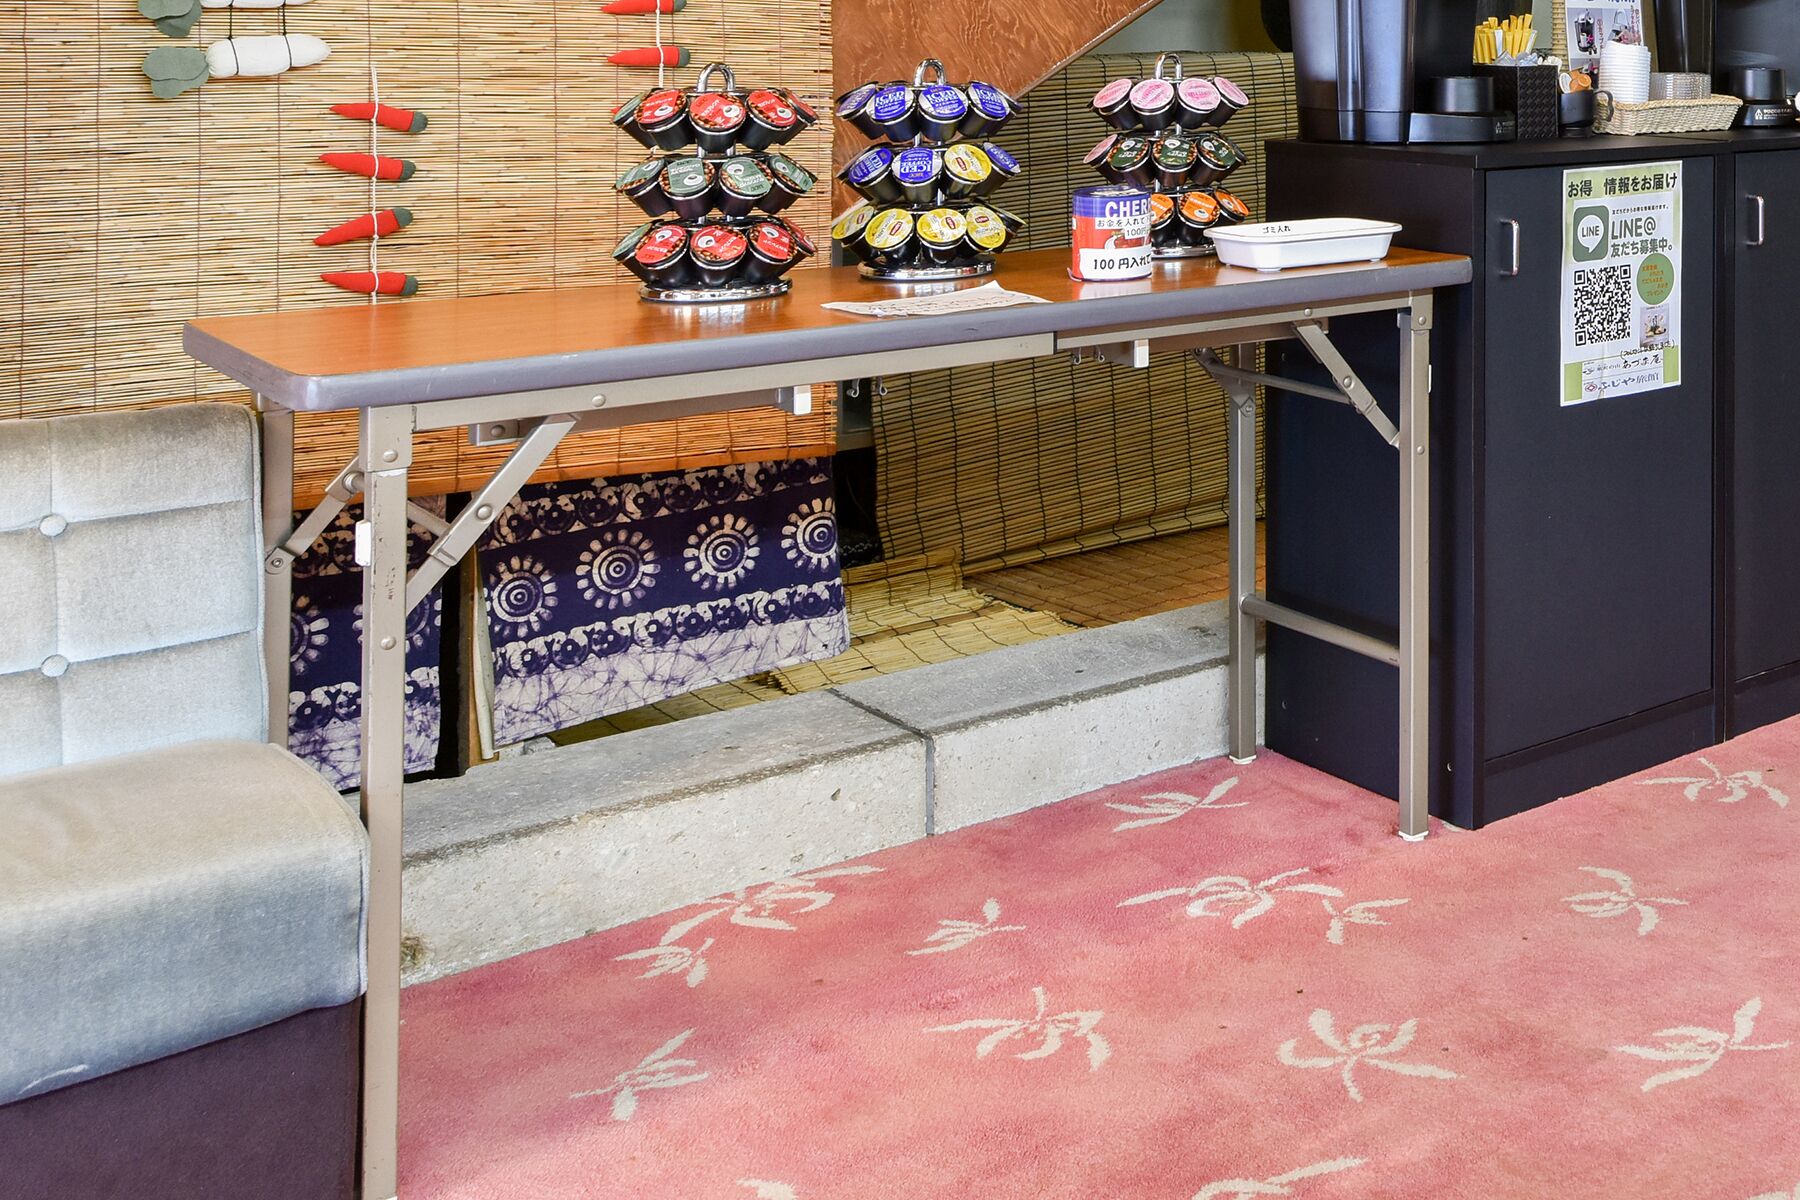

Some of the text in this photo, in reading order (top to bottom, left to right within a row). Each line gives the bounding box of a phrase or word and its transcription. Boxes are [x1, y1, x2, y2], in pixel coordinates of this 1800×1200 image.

[1567, 173, 1677, 198] お得 情報をお届け
[1581, 225, 1600, 238] LINE
[1611, 216, 1657, 240] LINE@
[1610, 237, 1673, 258] 友だち募集中。
